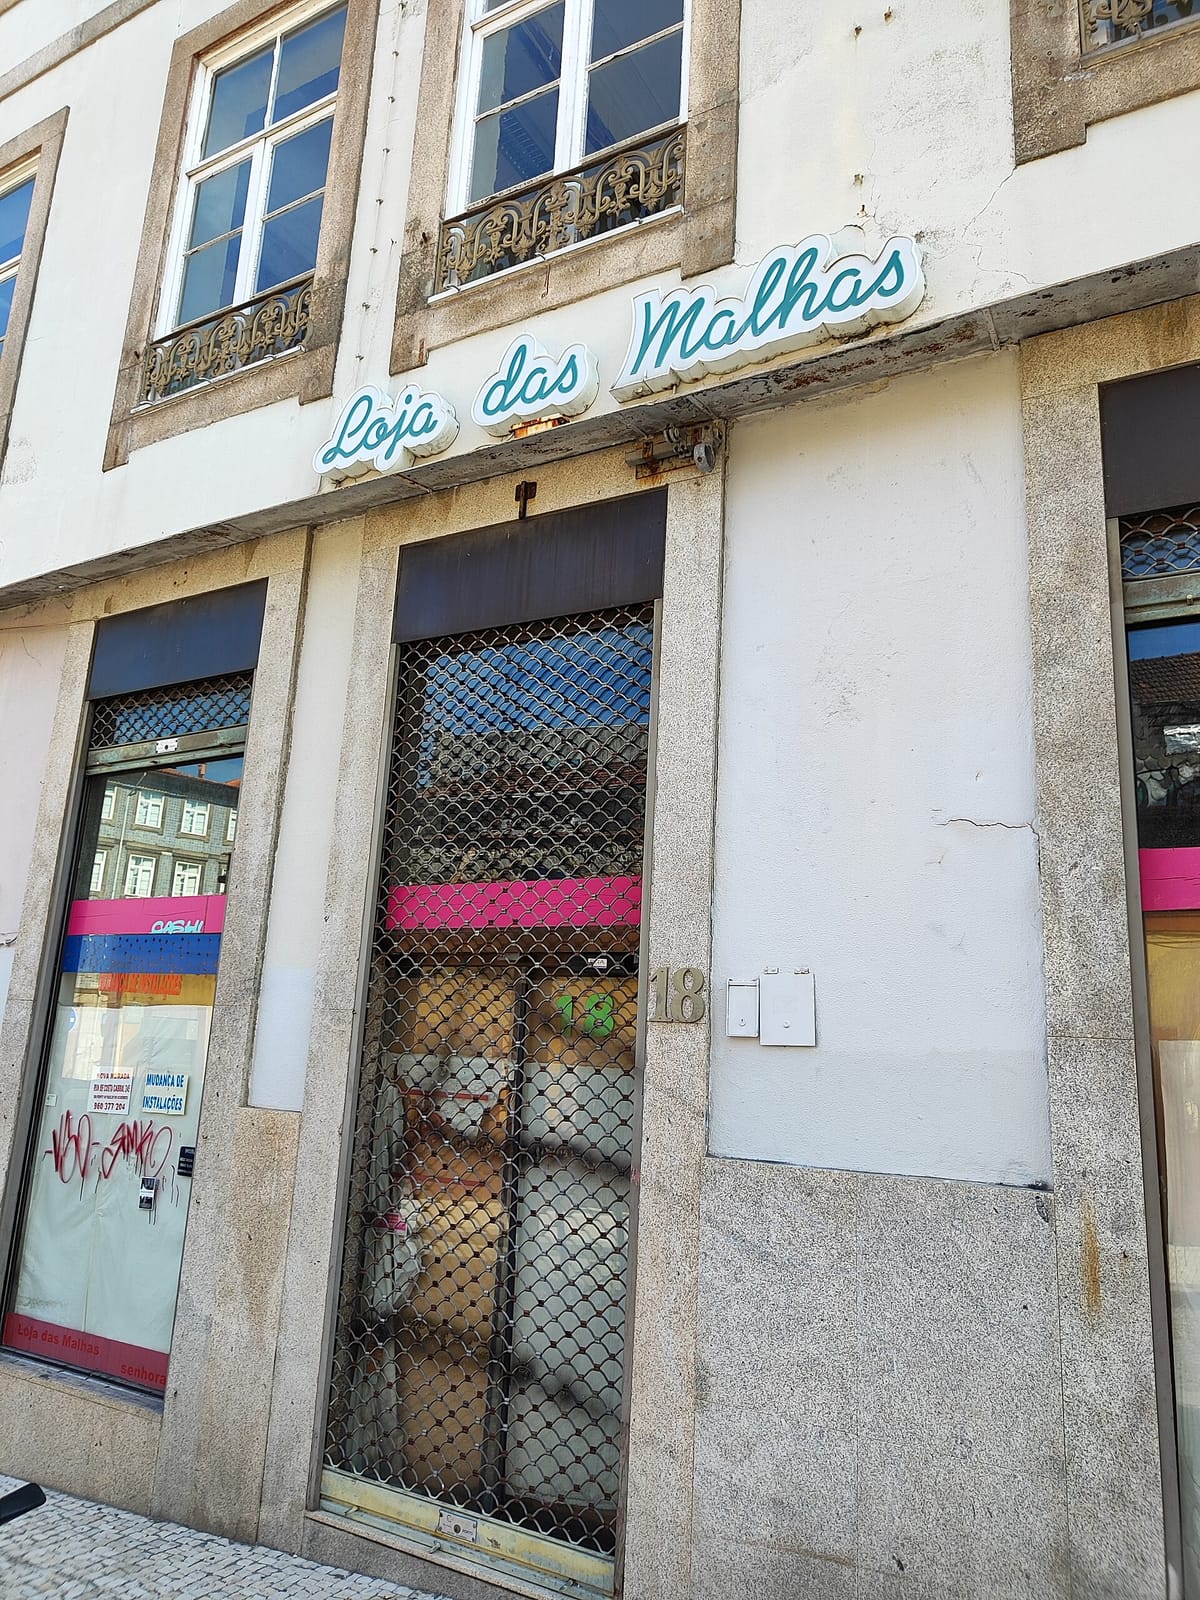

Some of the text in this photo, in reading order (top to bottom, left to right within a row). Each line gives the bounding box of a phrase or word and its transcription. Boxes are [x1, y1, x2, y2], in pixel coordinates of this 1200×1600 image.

[321, 247, 907, 465] Loja das Malhas
[649, 966, 706, 1023] 18
[556, 993, 615, 1038] 18
[96, 1072, 109, 1080] OVA
[146, 1073, 175, 1090] MUDANÇA
[176, 1074, 185, 1088] DE
[104, 1102, 115, 1111] 377
[115, 1102, 126, 1111] 204
[142, 1094, 184, 1113] INSTALAÇÕES
[17, 1323, 101, 1357] Loja das Malhas
[120, 1363, 167, 1386] senhora
